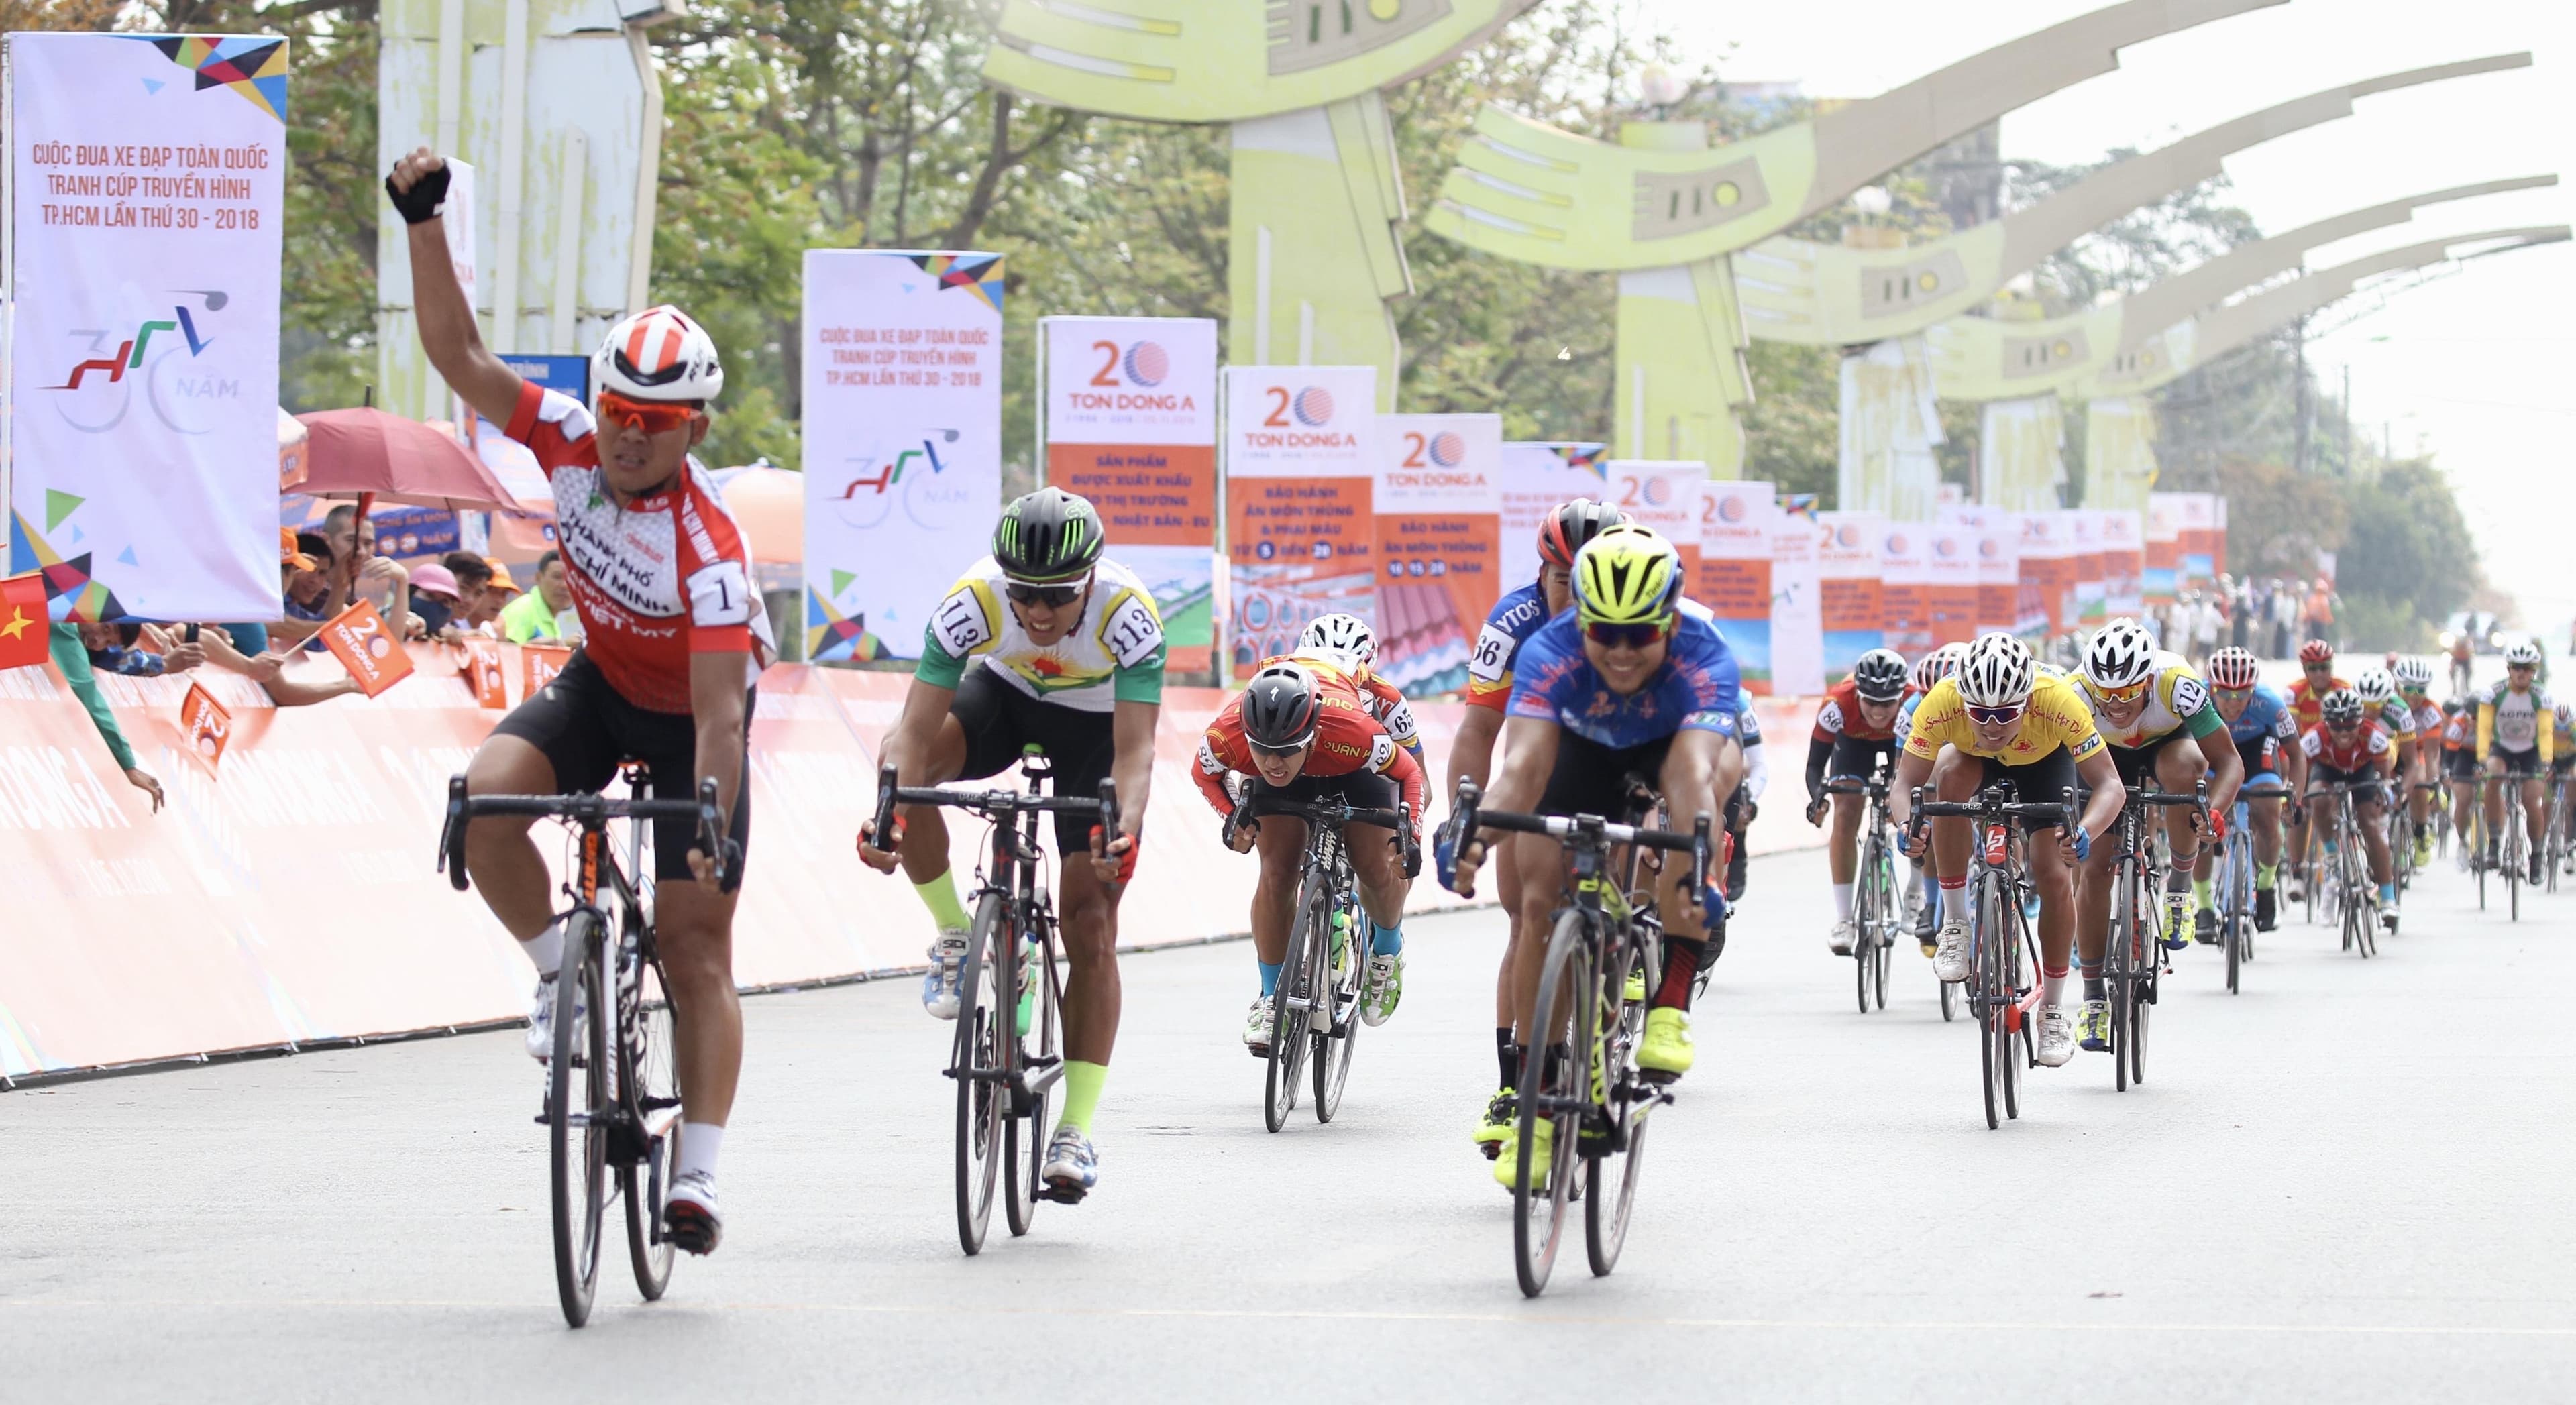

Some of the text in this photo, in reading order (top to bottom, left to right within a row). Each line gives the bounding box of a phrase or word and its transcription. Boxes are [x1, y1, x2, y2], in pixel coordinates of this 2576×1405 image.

[33, 141, 268, 171] CUỘC ĐUA XE ĐẠP TOÀN QUỐC
[48, 174, 101, 196] TRANH
[107, 172, 137, 197] CÚP
[210, 174, 250, 199] HÌNH
[42, 205, 99, 227] TP.HCM
[141, 205, 172, 228] THỨ
[177, 208, 197, 229] 30
[215, 208, 259, 229] 2018
[880, 329, 896, 344] XE
[833, 349, 871, 364] TRANH
[176, 378, 239, 400] NĂM
[924, 372, 940, 386] 30
[951, 372, 982, 387] 2018
[1068, 393, 1195, 411] TON DONG A
[1245, 432, 1357, 447] TON DONG A
[1386, 473, 1486, 486] TON DONG A
[714, 577, 734, 612] 1
[940, 598, 979, 649] 113
[1112, 608, 1155, 656] 113
[335, 622, 380, 681] TON DONG A
[1394, 708, 1415, 734] 65
[2074, 732, 2099, 756] HTV
[2167, 895, 2184, 903] SIDI
[1944, 928, 1962, 936] SIDI
[942, 940, 967, 950] SIDI
[1371, 962, 1388, 972] SIDI
